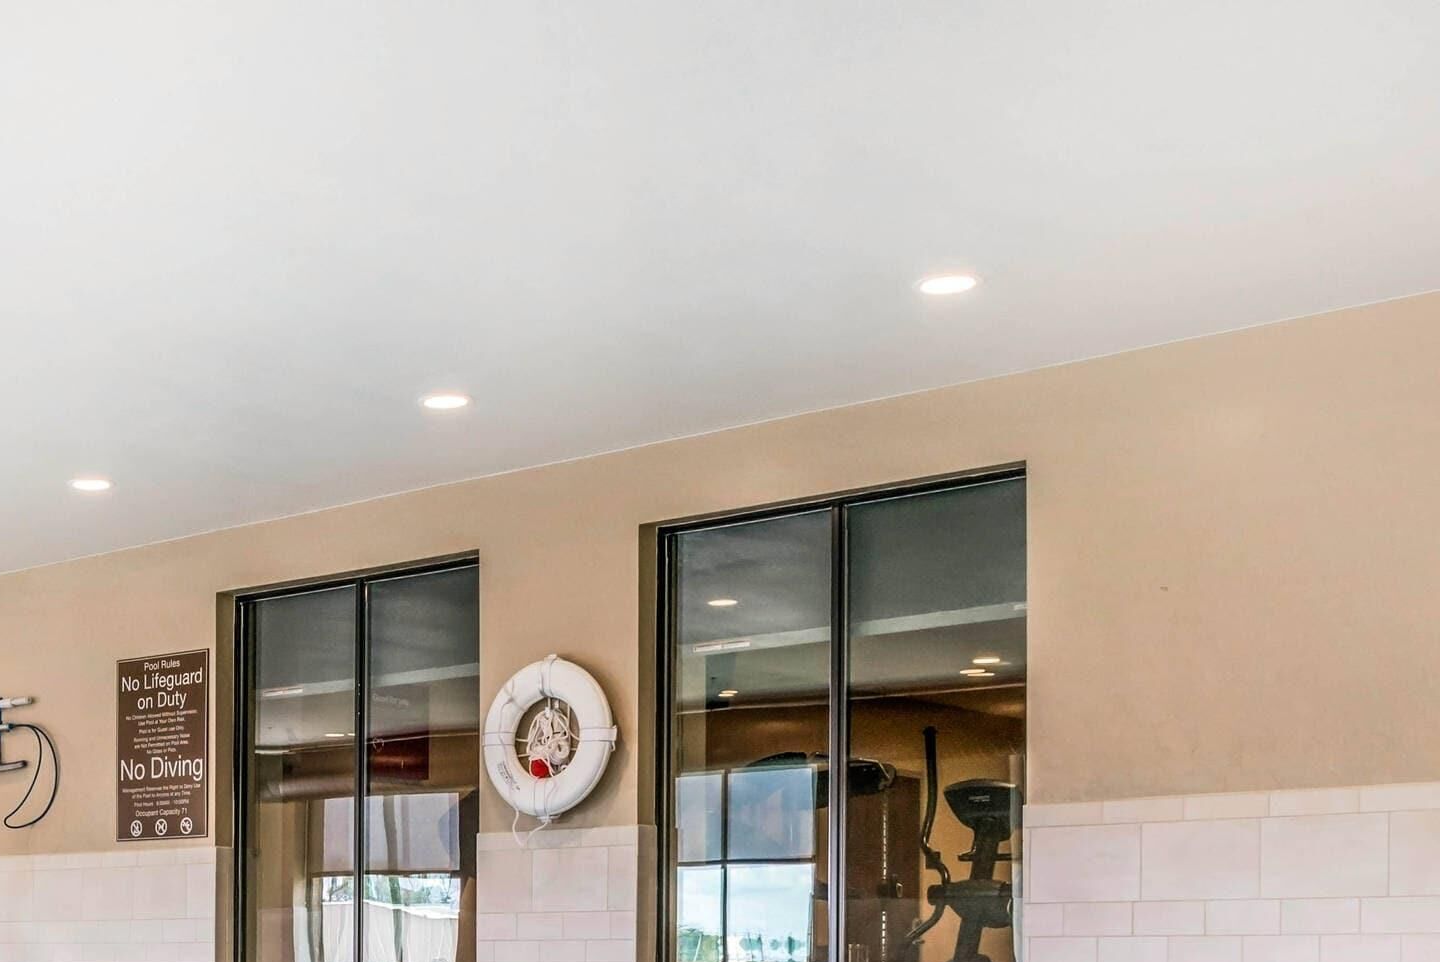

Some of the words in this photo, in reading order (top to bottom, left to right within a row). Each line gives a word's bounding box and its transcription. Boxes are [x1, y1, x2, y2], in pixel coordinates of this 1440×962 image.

[144, 661, 160, 671] Pool
[161, 659, 180, 669] Rules
[121, 676, 140, 693] No
[144, 666, 203, 691] Lifeguard
[137, 696, 153, 710] on
[157, 691, 187, 710] Duty
[120, 759, 146, 782] No
[151, 754, 204, 782] Diving
[135, 809, 159, 817] Occupant
[159, 808, 180, 816] Capacity
[181, 807, 188, 815] 71
